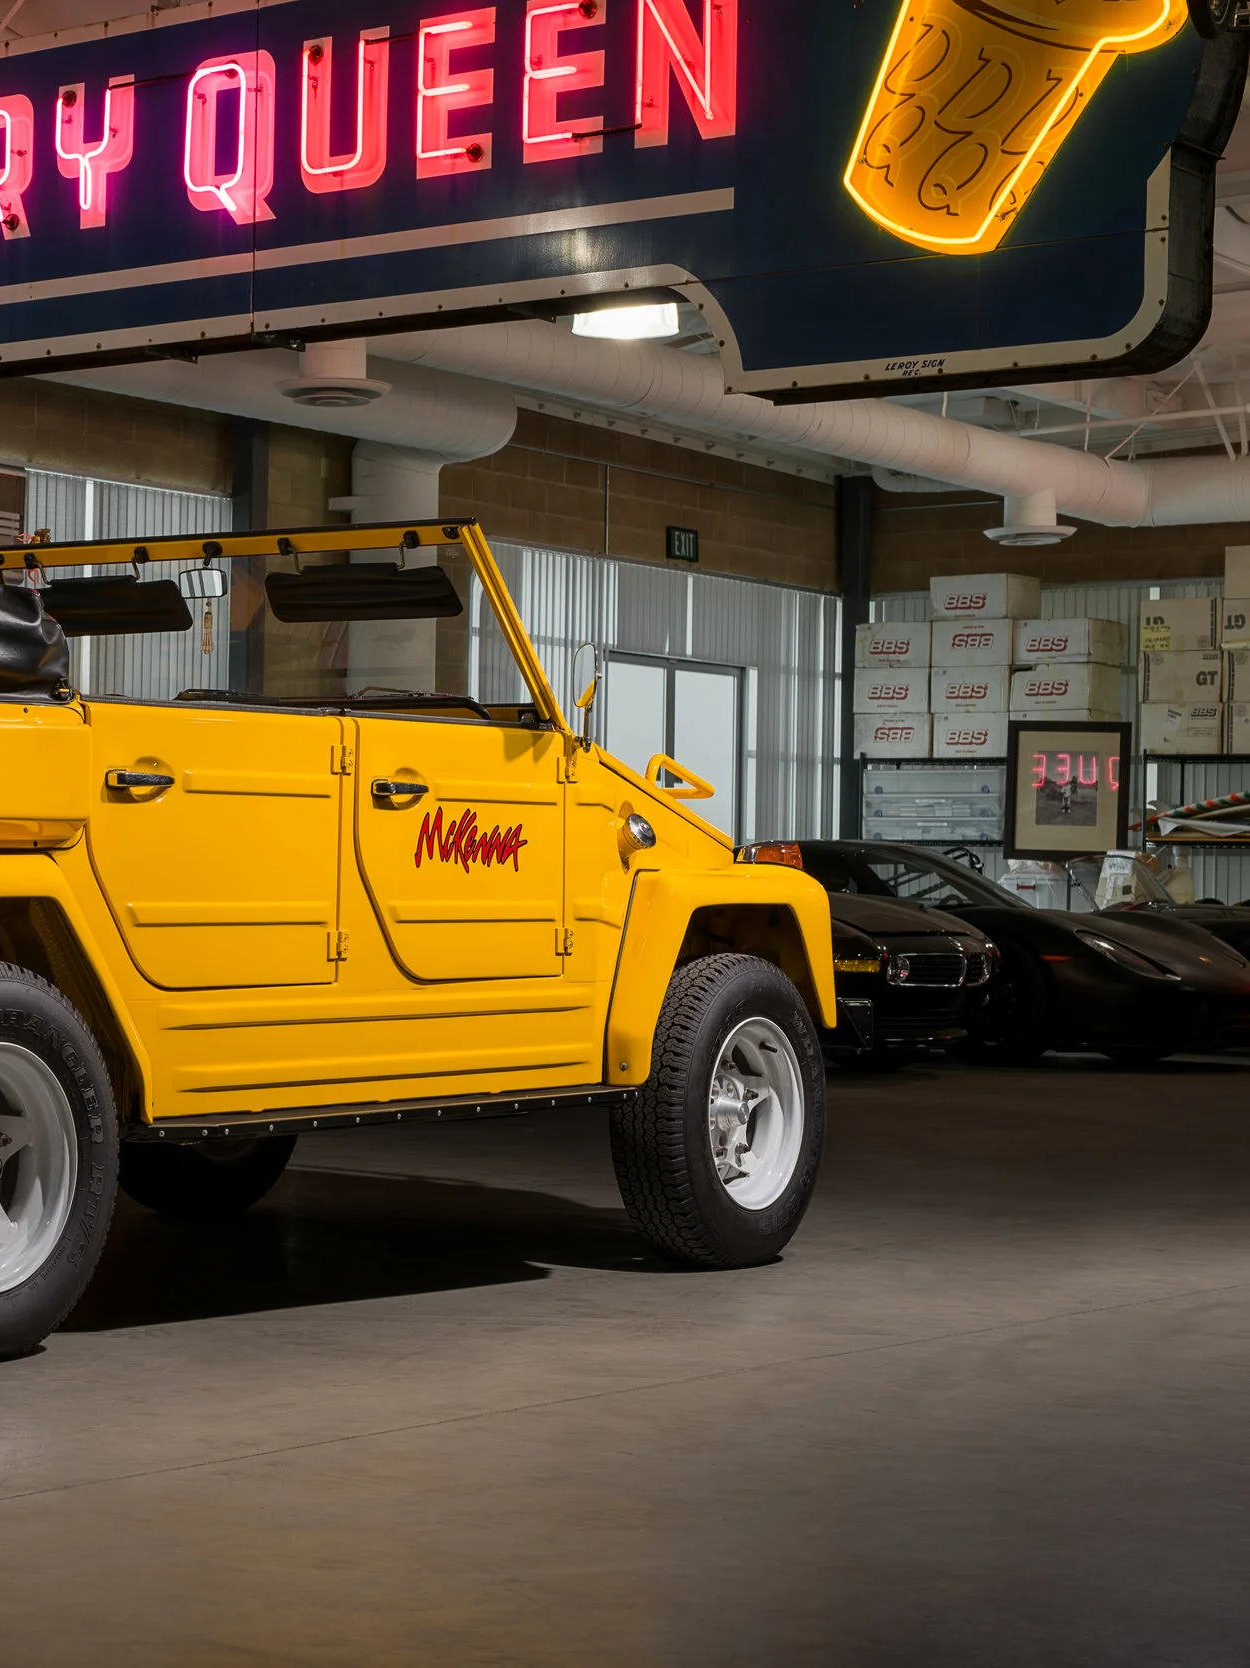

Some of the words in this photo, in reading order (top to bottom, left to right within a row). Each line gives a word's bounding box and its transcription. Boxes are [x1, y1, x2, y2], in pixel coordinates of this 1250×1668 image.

[184, 0, 738, 225] QUEEN
[885, 361, 919, 371] LEROY
[921, 359, 946, 369] SIGN
[674, 531, 694, 557] EXIT
[944, 593, 987, 610] BBS
[869, 638, 910, 655] BBS
[952, 632, 994, 649] BBS
[1026, 636, 1068, 652] BBS
[1195, 670, 1218, 686] GT
[868, 684, 909, 700] BBS
[945, 683, 988, 699] BBS
[1025, 679, 1068, 696] BBS
[874, 727, 915, 743] BBS
[945, 729, 988, 745] BBS
